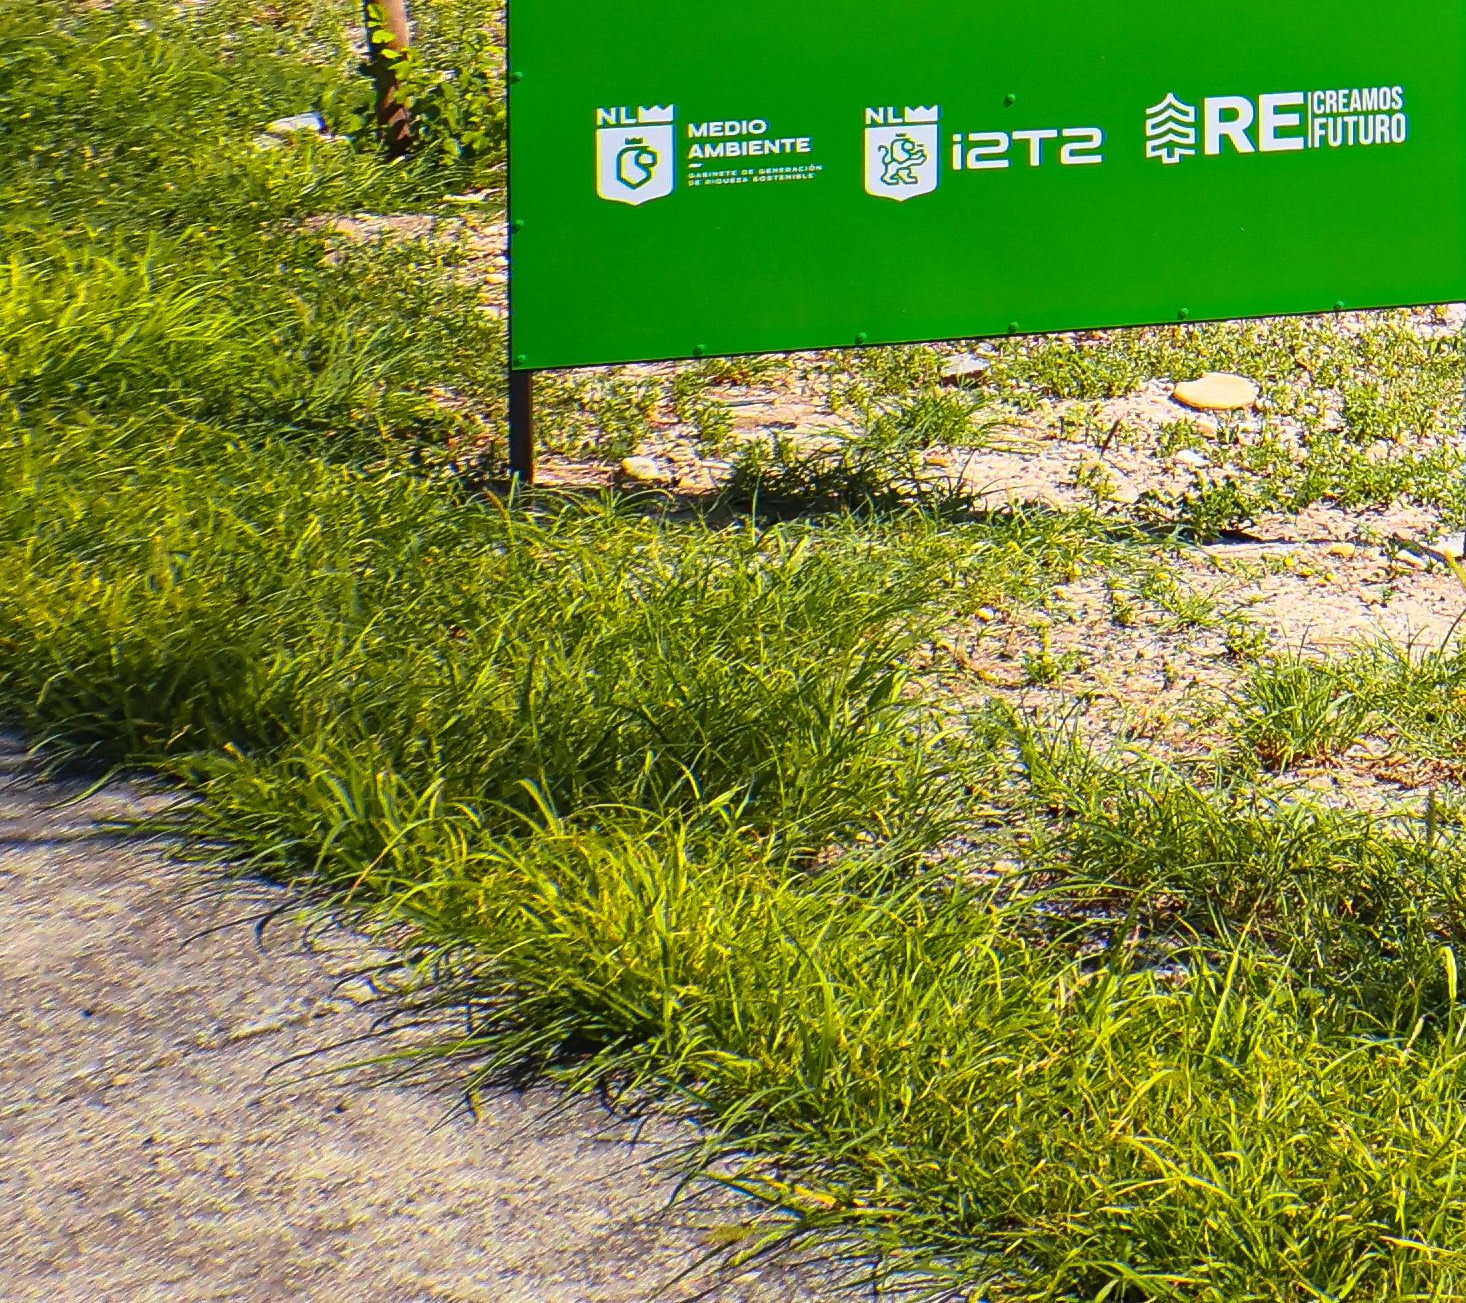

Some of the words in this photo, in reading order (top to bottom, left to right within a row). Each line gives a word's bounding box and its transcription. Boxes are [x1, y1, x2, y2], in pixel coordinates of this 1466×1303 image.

[1312, 86, 1403, 114] CREAMOS
[596, 106, 637, 125] NL
[864, 106, 903, 125] NL
[1204, 92, 1305, 156] RE
[687, 119, 767, 138] MEDIO
[1312, 113, 1406, 148] FUTURO
[687, 137, 811, 159] AMBIENTE
